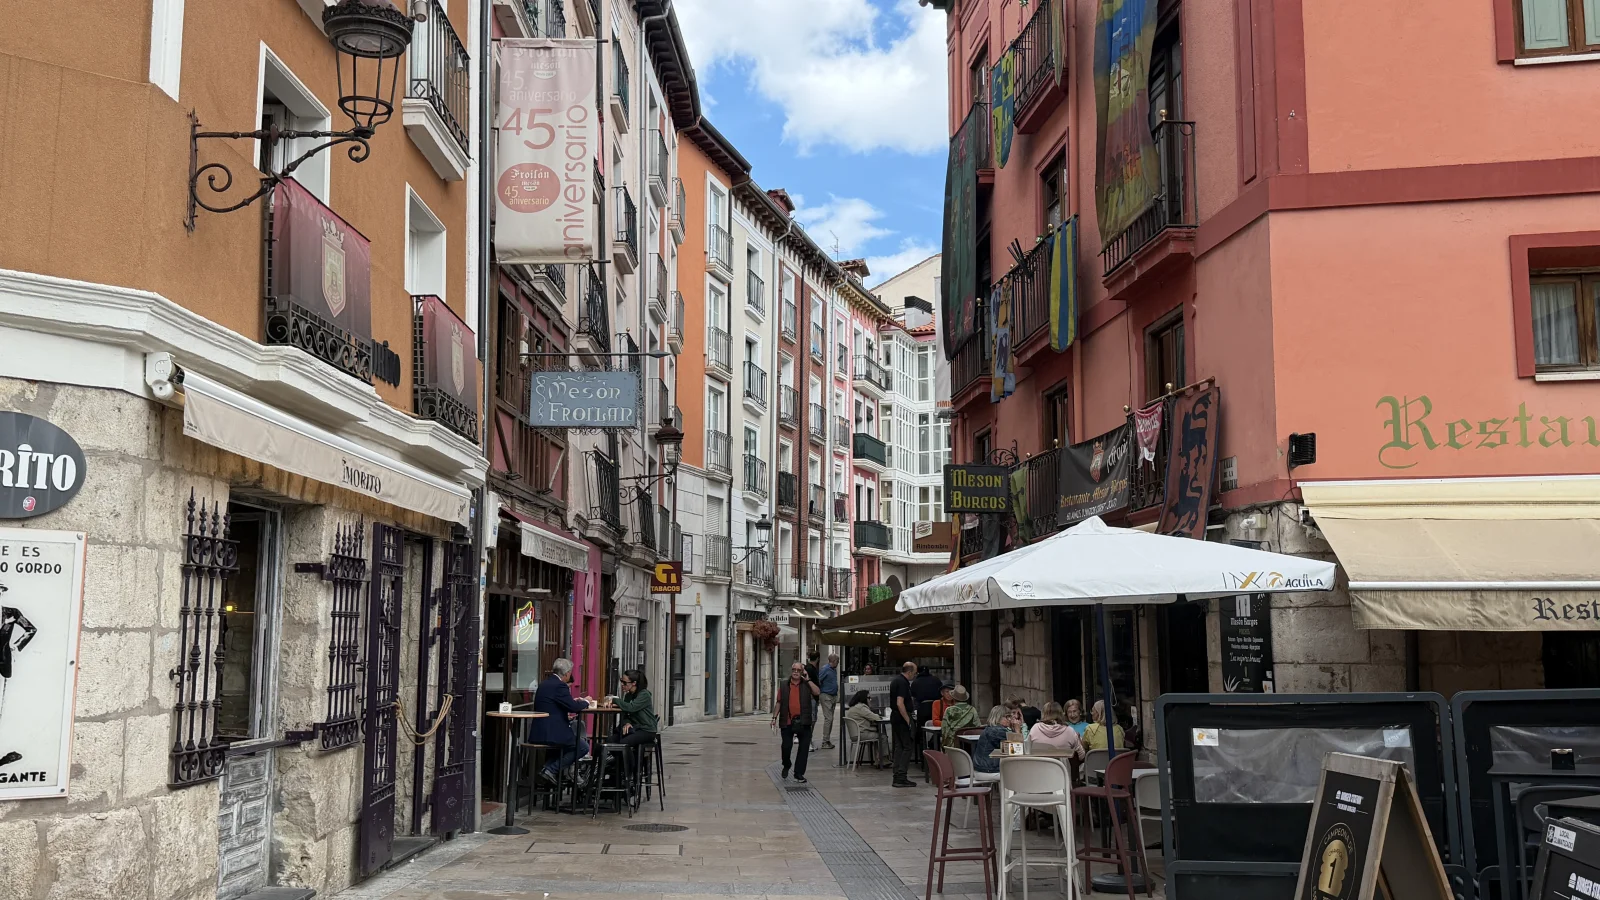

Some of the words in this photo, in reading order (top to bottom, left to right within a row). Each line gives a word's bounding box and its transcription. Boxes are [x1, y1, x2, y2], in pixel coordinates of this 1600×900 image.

[502, 107, 555, 149] 45
[510, 195, 549, 205] aniversario
[22, 546, 40, 557] ES
[16, 562, 62, 575] GORDO
[1328, 858, 1337, 888] 1
